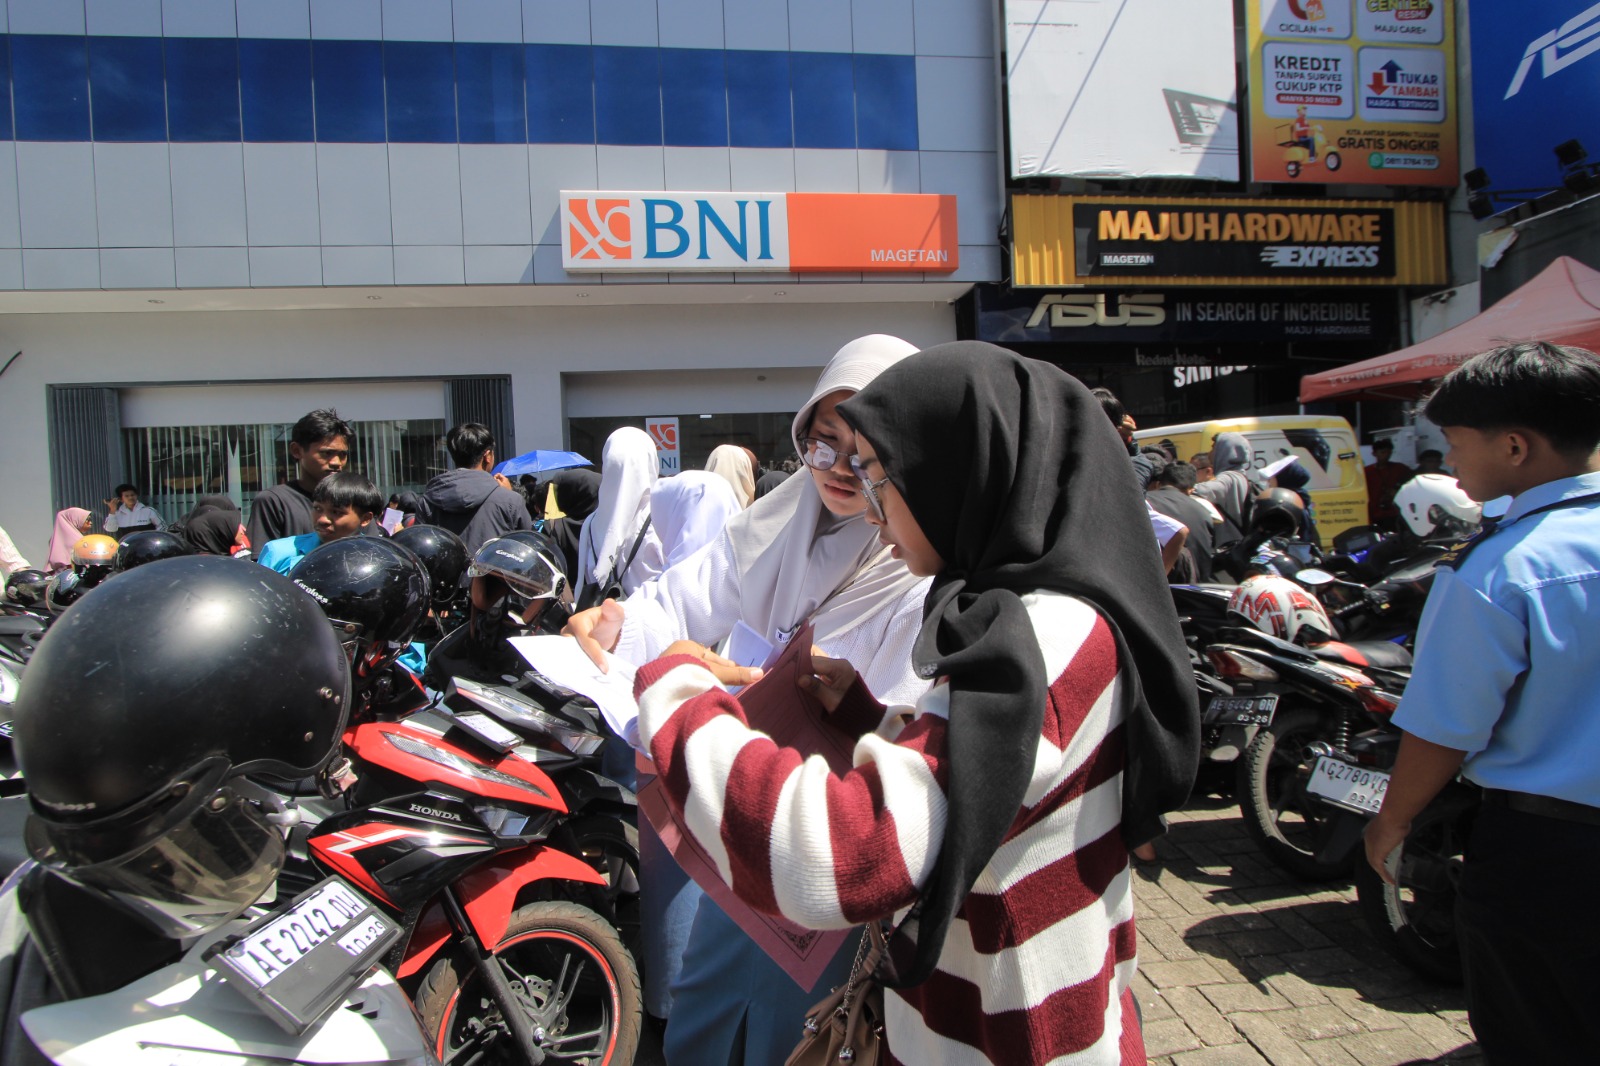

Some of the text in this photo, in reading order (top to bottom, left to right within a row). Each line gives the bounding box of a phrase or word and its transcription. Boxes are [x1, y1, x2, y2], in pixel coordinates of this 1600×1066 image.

[1367, 0, 1429, 12] CENTER
[1398, 11, 1426, 19] RESMI
[1279, 23, 1317, 33] CICILAN
[1374, 24, 1398, 33] MAJU
[1274, 55, 1341, 72] KREDIT
[1275, 71, 1342, 82] TANPA SURVEI
[1400, 73, 1438, 85] TUKAR
[1275, 81, 1342, 93] CUKUP KTP
[1392, 85, 1439, 97] TAMBAH
[1280, 95, 1304, 103] HANYA
[1368, 99, 1437, 109] HARGA TERTINGGI
[1338, 137, 1440, 151] GRATIS ONGKIR
[641, 199, 774, 263] BNI
[870, 249, 948, 262] MAGETAN
[1103, 255, 1154, 264] MAGETAN
[1270, 246, 1379, 267] EXPRESS
[1024, 293, 1165, 328] ASUS
[1176, 302, 1371, 322] IN SEARCH OF INCREDIBLE
[1285, 326, 1371, 335] MAJU HARDWARE
[661, 457, 677, 469] NI
[1210, 699, 1225, 711] AE
[408, 803, 462, 822] HONDA
[247, 938, 294, 979] AE
[279, 907, 340, 955] 2242
